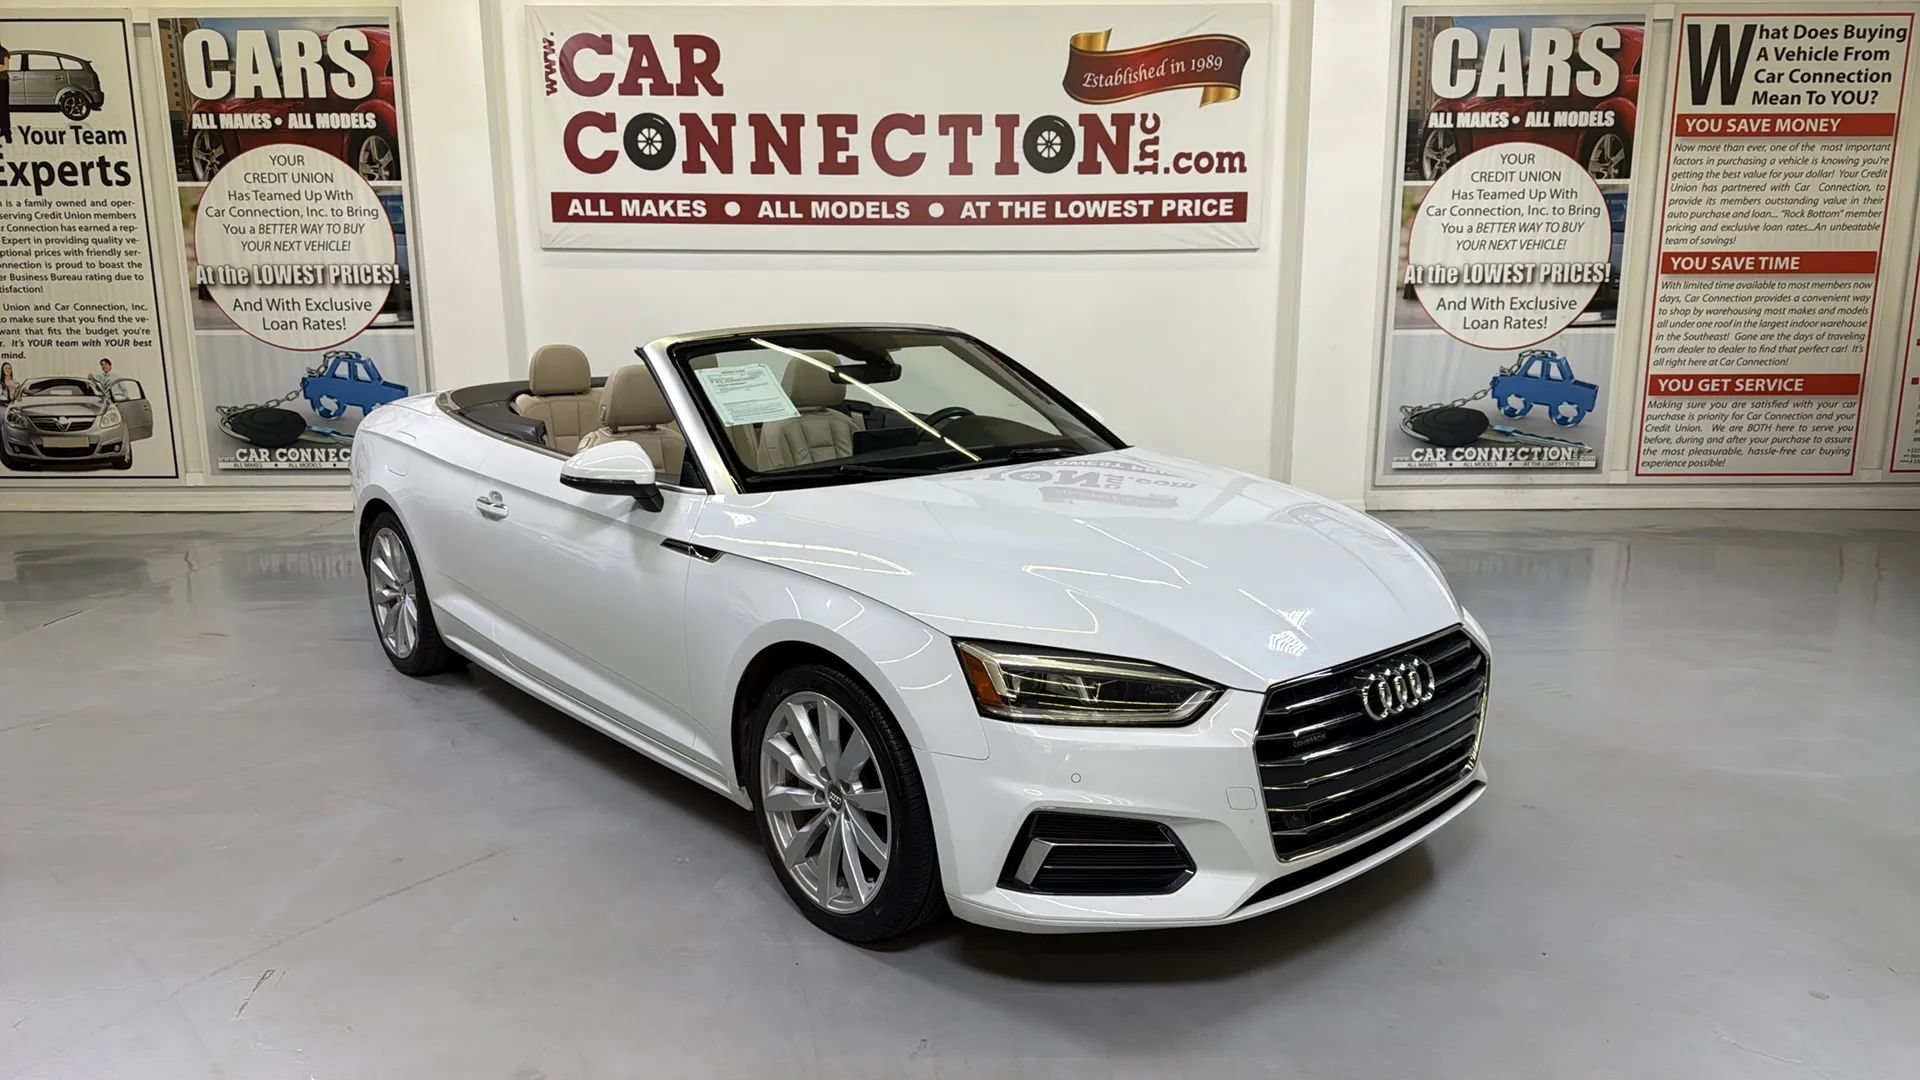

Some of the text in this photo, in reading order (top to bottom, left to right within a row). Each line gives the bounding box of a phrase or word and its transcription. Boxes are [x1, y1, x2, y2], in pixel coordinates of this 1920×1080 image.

[1794, 25, 1839, 40] Does
[1843, 25, 1908, 42] Buying
[1756, 47, 1890, 61] A Vehicle From
[183, 28, 374, 100] CARS
[543, 32, 558, 96] www.
[559, 32, 724, 97] CAR
[1431, 27, 1621, 99] CARS
[1082, 55, 1223, 89] Established in 1989
[1754, 69, 1892, 84] Car Connection
[1752, 91, 1878, 105] Mean To YOU?
[192, 112, 376, 130] ALL MAKES ALL MODELS
[1428, 111, 1615, 128] ALL MAKES ALL MODELS
[1686, 119, 1841, 133] YOU SAVE MONEY
[18, 126, 127, 145] Your Team
[563, 110, 1136, 177] CONNECTION
[269, 155, 305, 166] YOUR
[1164, 151, 1248, 174] .com
[1500, 154, 1535, 165] YOUR
[244, 173, 333, 184] CREDIT UNION
[1471, 171, 1561, 182] CREDIT UNION
[228, 190, 353, 203] Has Teamed Up With
[1452, 188, 1578, 202] Has Teamed Up With
[205, 207, 379, 219] Car Connection, Inc. to Bring
[568, 199, 1233, 219] ALL MAKES ALL MODELS AT THE LOWEST PRICE
[1426, 205, 1601, 217] Car Connection, Inc. to Bring
[223, 224, 365, 235] You a BETTER WAY TO BUY
[1441, 222, 1584, 234] You a BETTER WAY TO BUY
[2, 237, 31, 245] Expert
[45, 237, 89, 246] providing
[91, 237, 122, 245] quality
[241, 241, 351, 251] YOUR NEXT VEHICLE!
[1456, 239, 1567, 251] YOUR NEXT VEHICLE!
[1671, 257, 1800, 270] YOU SAVE TIME
[10, 273, 48, 281] Business
[85, 273, 112, 283] rating
[196, 264, 400, 285] At the LOWEST PRICES!
[1404, 262, 1611, 284] At the LOWEST PRICES!
[34, 303, 50, 311] and
[74, 303, 128, 312] Connection,
[132, 303, 148, 311] Inc.
[233, 298, 372, 311] And With Exclusive
[1436, 297, 1577, 311] And With Exclusive
[262, 318, 346, 331] Loan Rates!
[1463, 317, 1548, 330] Loan Rates!
[82, 339, 101, 347] with
[133, 339, 152, 347] best
[1653, 358, 1664, 366] all
[1665, 358, 1686, 368] right
[1688, 358, 1707, 366] here
[1719, 357, 1735, 366] Car
[1736, 357, 1789, 366] Connection!
[1658, 379, 1804, 392] YOU GET SERVICE
[1645, 424, 1670, 432] Credit
[1674, 424, 1702, 432] Union.
[1712, 424, 1726, 432] We
[1747, 424, 1772, 432] BOTH
[1775, 424, 1794, 432] here
[1838, 425, 1854, 433] you
[236, 449, 351, 462] CAR CONNEC
[1412, 448, 1446, 461] CAR
[1452, 447, 1574, 461] CONNECTION
